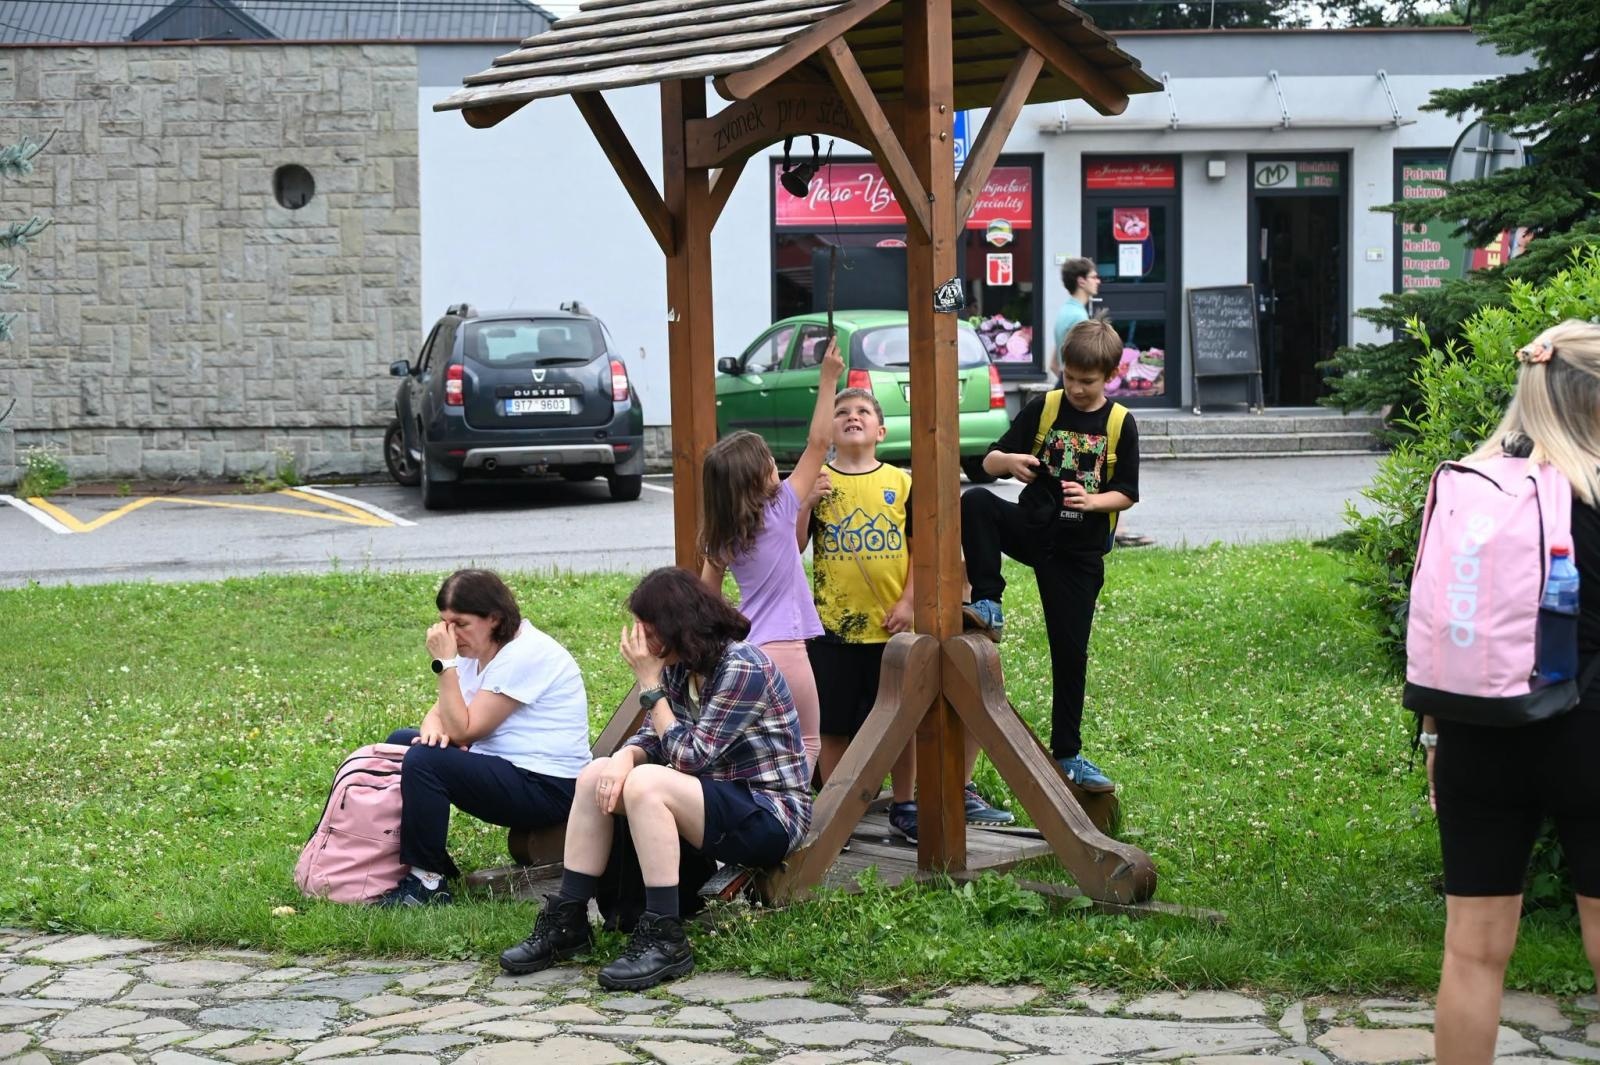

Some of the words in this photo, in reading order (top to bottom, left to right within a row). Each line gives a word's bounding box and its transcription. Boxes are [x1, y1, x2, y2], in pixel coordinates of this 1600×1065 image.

[713, 103, 766, 152] zvonek
[776, 97, 807, 132] pro
[1402, 239, 1441, 253] Nealko
[1402, 256, 1450, 273] Drogerie
[514, 399, 533, 411] 9T7
[540, 399, 566, 410] 9603
[1447, 512, 1496, 648] adidas
